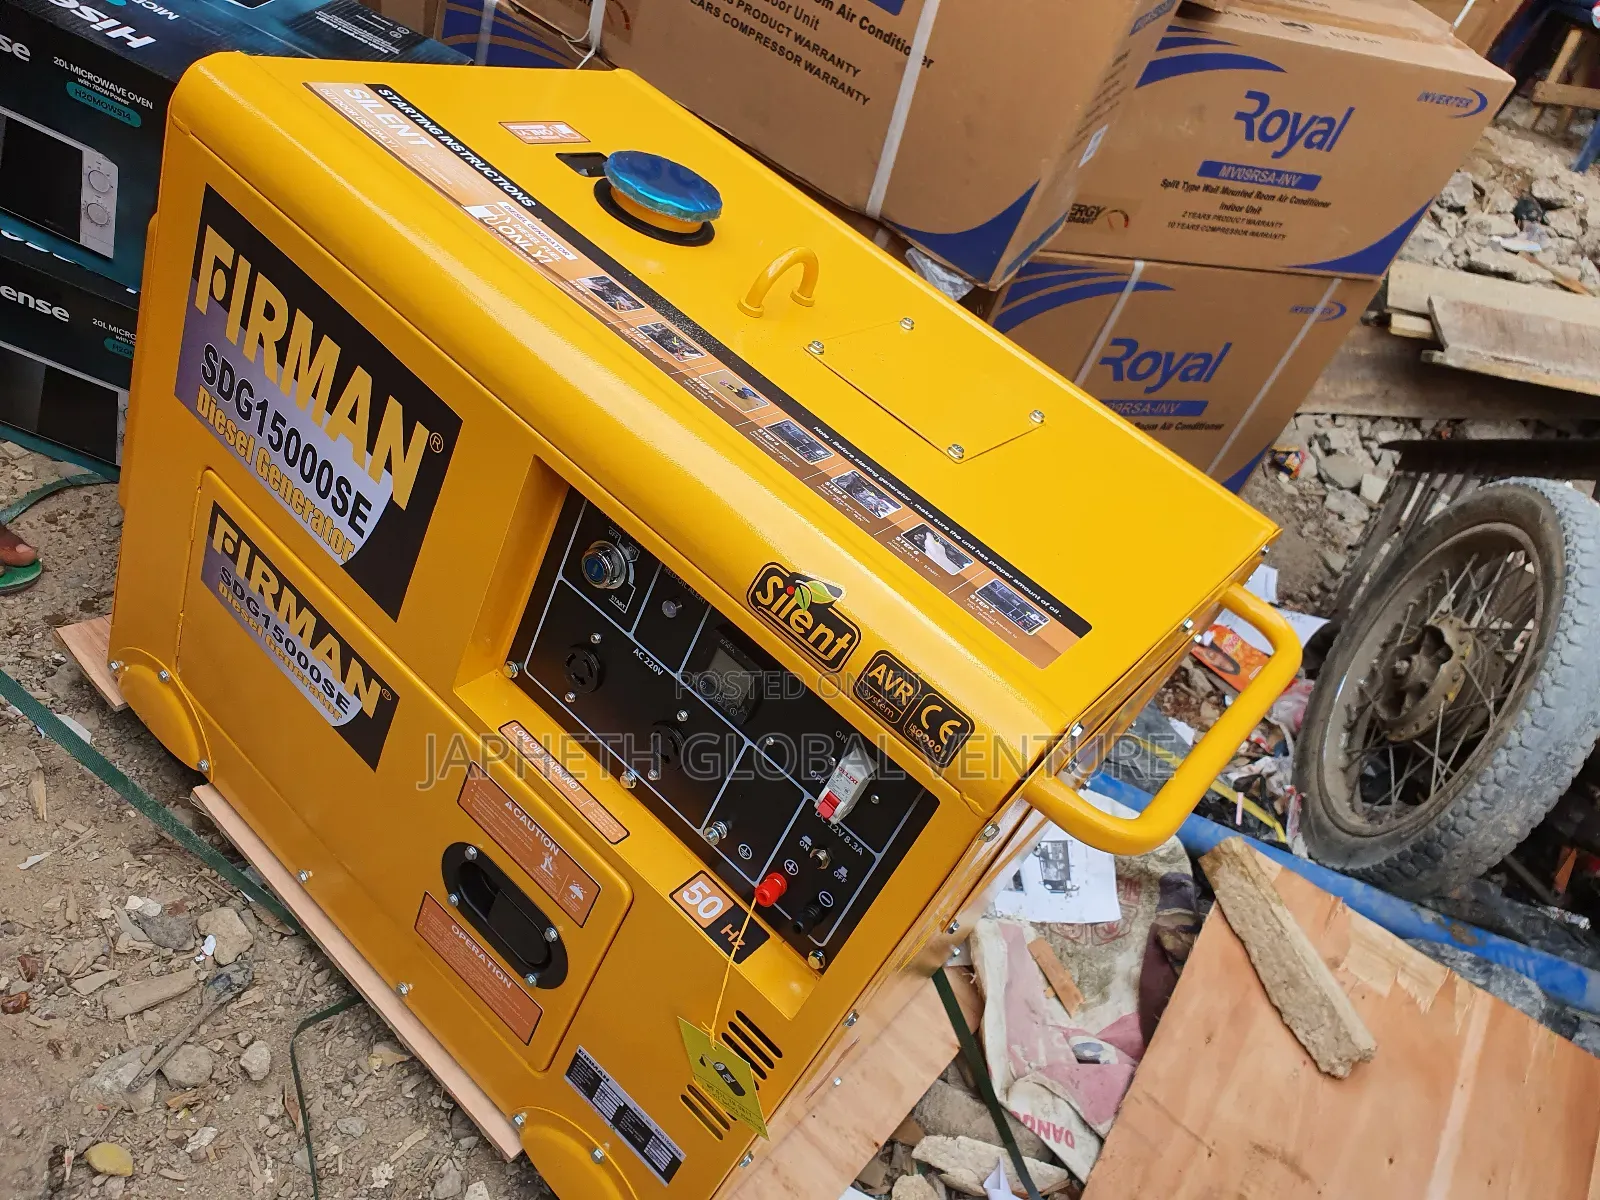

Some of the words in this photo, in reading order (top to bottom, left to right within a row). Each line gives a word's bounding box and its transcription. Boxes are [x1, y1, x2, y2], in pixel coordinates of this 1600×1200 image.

[736, 1, 793, 38] PRODUCT
[793, 28, 862, 78] WARRANTY
[793, 10, 820, 31] Unit
[836, 3, 857, 24] Air
[859, 16, 935, 70] Conditioer
[722, 12, 802, 67] COMPRESSOR
[804, 60, 870, 106] WARRANTY
[53, 56, 69, 70] 20L
[70, 63, 127, 97] MICROWAVE
[127, 91, 153, 110] OVEN
[77, 77, 92, 88] with
[92, 84, 109, 97] 700W
[109, 92, 130, 105] Power
[320, 88, 357, 116] OUTDOOR
[355, 115, 374, 131] USE
[344, 88, 435, 149] SILENT
[1234, 90, 1356, 159] Royal
[378, 89, 444, 139] STARTING
[438, 136, 536, 208] INSTRUCTIONS
[1160, 178, 1180, 191] Split
[1181, 181, 1201, 193] Type
[1202, 184, 1220, 194] Wall
[1220, 186, 1254, 199] Mounted
[1254, 191, 1276, 201] Room
[1277, 194, 1289, 203] Air
[1289, 196, 1332, 208] Conditioner
[1219, 202, 1244, 213] Indoor
[1245, 203, 1263, 215] Unit
[504, 205, 527, 224] DIESEL
[528, 223, 571, 256] GENERATOR
[1176, 223, 1200, 232] YEARS
[1201, 226, 1252, 236] COMPRESSOR
[1250, 231, 1287, 240] WARRANTY
[1188, 212, 1211, 220] YEARS
[1212, 214, 1246, 224] PRODUCT
[1245, 219, 1283, 228] WARRANTY
[498, 225, 553, 264] ONLY!
[513, 223, 541, 245] DIESEL
[539, 245, 561, 262] FUEL
[92, 317, 108, 330] 20L
[115, 335, 129, 345] with
[194, 223, 430, 511] FIRMAN
[1099, 337, 1232, 394] Royal
[201, 343, 373, 539] SDG15000SE
[757, 428, 776, 443] STEP
[1160, 422, 1174, 430] Air
[1174, 421, 1224, 431] Conditioner
[196, 384, 256, 465] Diesel
[256, 447, 355, 563] Generator
[824, 481, 844, 497] STEP
[608, 529, 620, 540] OFF
[833, 441, 855, 459] Before
[854, 458, 879, 478] starting
[915, 503, 933, 519] make
[934, 518, 949, 531] sure
[950, 530, 962, 541] the
[962, 539, 975, 551] unit
[975, 549, 989, 562] has
[988, 559, 1014, 580] proper
[1013, 578, 1041, 601] amount
[1040, 599, 1050, 607] of
[895, 536, 914, 551] STEP
[628, 545, 638, 555] ON
[212, 513, 381, 719] FIRMAN
[610, 594, 627, 610] START
[756, 576, 852, 660] Silent
[969, 594, 990, 609] STEP
[218, 580, 263, 637] Diesel
[265, 633, 342, 721] Generator
[220, 566, 350, 715] SDG15000SE
[633, 648, 644, 660] AC
[644, 658, 664, 676] 220V
[863, 689, 894, 718] system
[868, 663, 914, 706] AVR
[835, 730, 848, 744] ON
[512, 725, 532, 745] LOW
[529, 739, 543, 756] OIL
[541, 753, 581, 793] WARNING!
[810, 770, 826, 784] OFF
[838, 766, 859, 785] DELIXI
[513, 807, 560, 856] CAUTION
[799, 840, 810, 852] ON
[828, 821, 845, 838] 12V
[844, 835, 863, 856] 8.3A
[833, 870, 848, 884] OFF
[682, 880, 724, 919] 50
[720, 923, 746, 951] Hz
[451, 925, 512, 989] OPERATION
